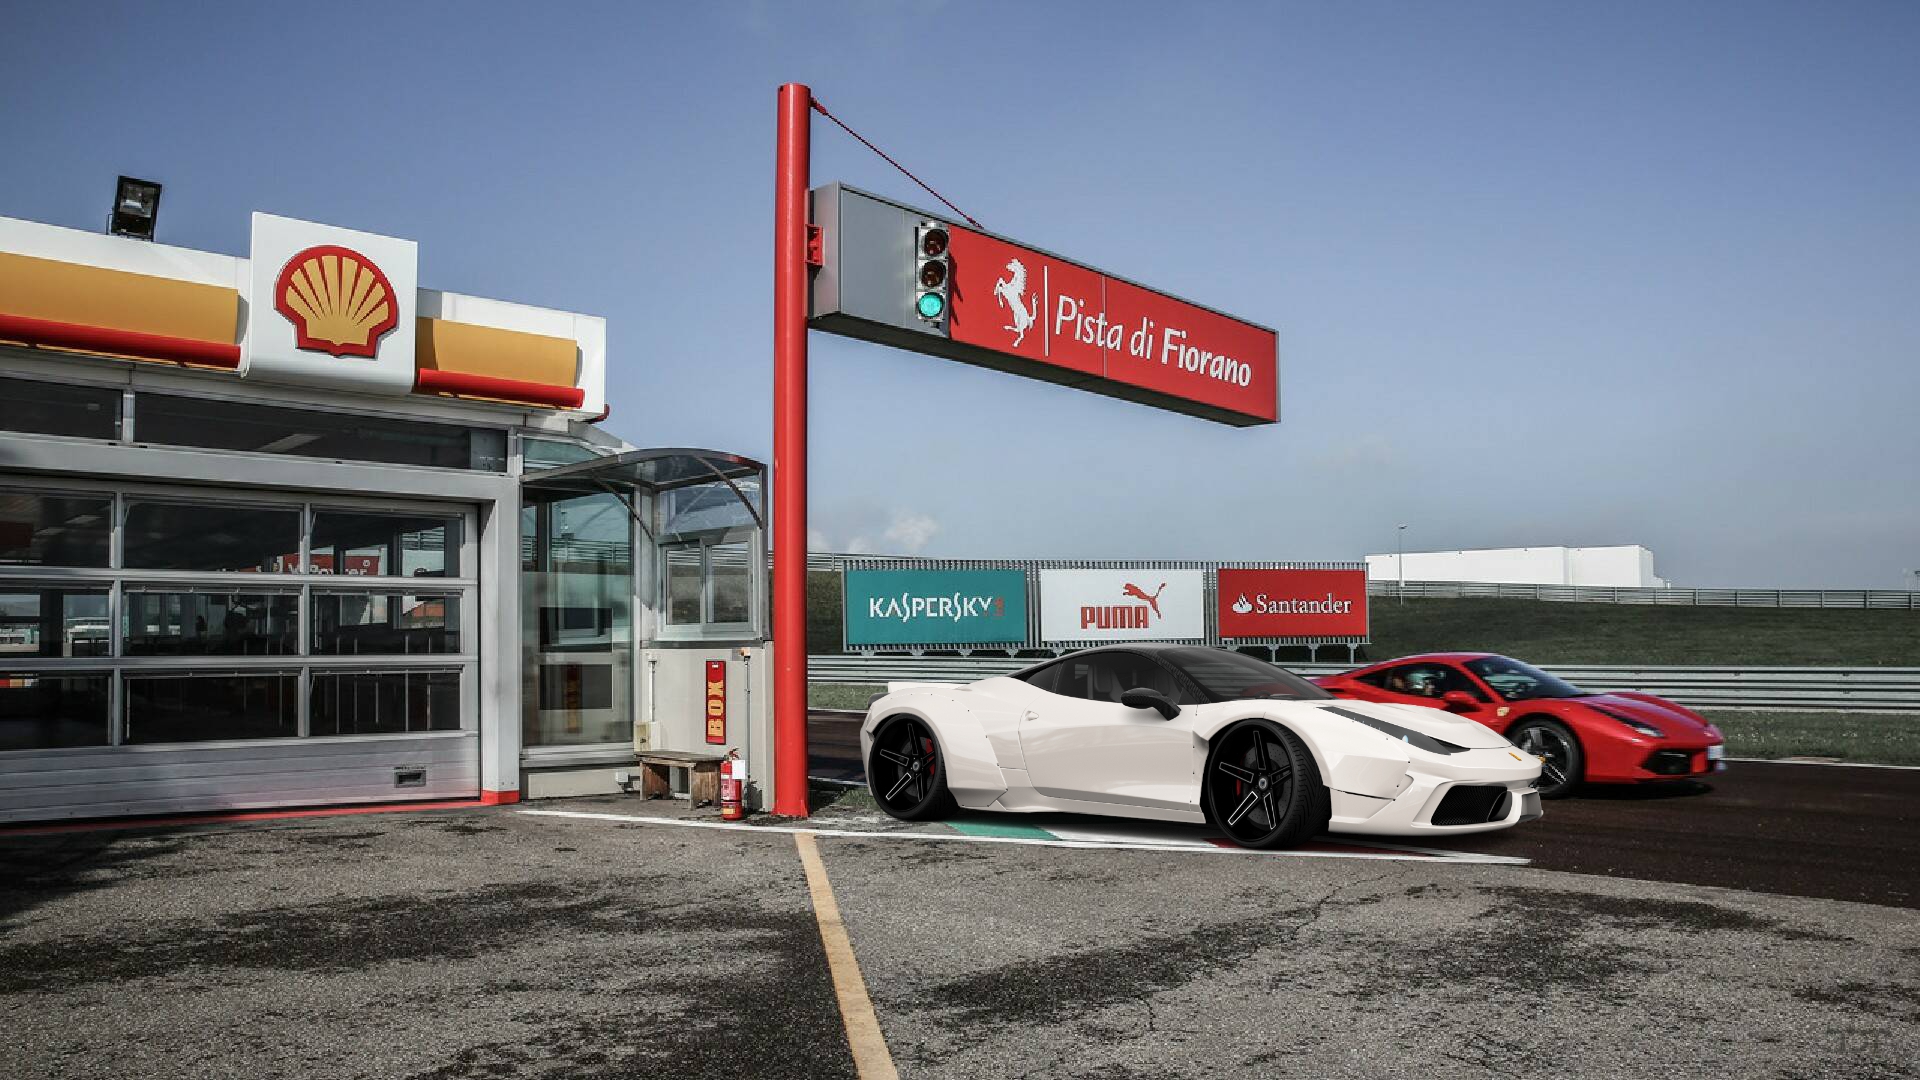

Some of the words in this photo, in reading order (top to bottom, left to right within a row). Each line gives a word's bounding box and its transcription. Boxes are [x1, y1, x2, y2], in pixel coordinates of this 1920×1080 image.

[1056, 295, 1122, 351] Pista
[1130, 317, 1153, 360] di
[1161, 328, 1252, 388] Fiorano
[869, 592, 993, 623] KASPERSKY
[1080, 603, 1149, 630] PUMA
[1255, 593, 1352, 615] Santander
[707, 680, 724, 737] BOX
